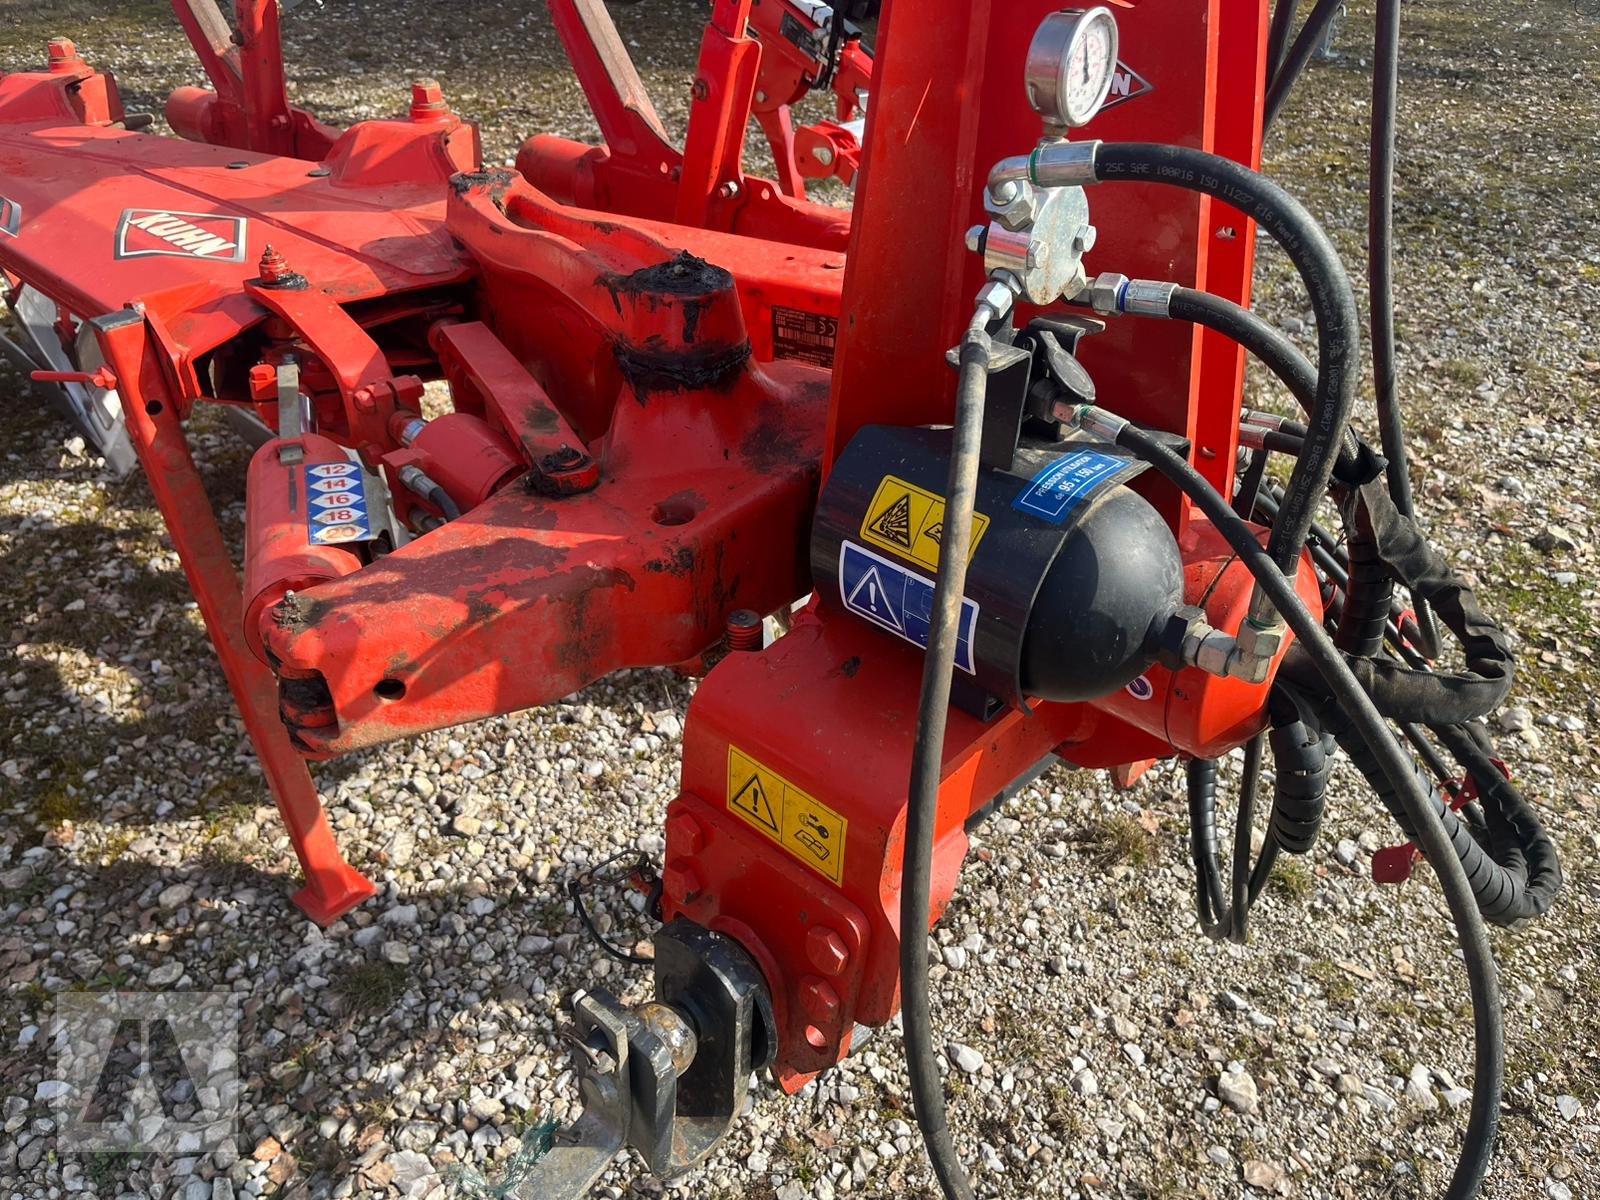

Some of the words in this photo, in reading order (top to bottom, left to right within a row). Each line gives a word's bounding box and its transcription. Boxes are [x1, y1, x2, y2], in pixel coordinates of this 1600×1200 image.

[1104, 162, 1126, 172] 2SC
[1129, 162, 1151, 174] SAE
[1199, 174, 1219, 189] ISO
[127, 212, 238, 256] KUHN
[321, 465, 345, 475] 12
[323, 479, 347, 489] 14
[1034, 472, 1066, 497] PRESSION
[1058, 480, 1076, 492] 95
[1075, 467, 1095, 478] 150
[325, 494, 350, 505] 16
[326, 510, 352, 521] 18
[326, 527, 357, 539] 20
